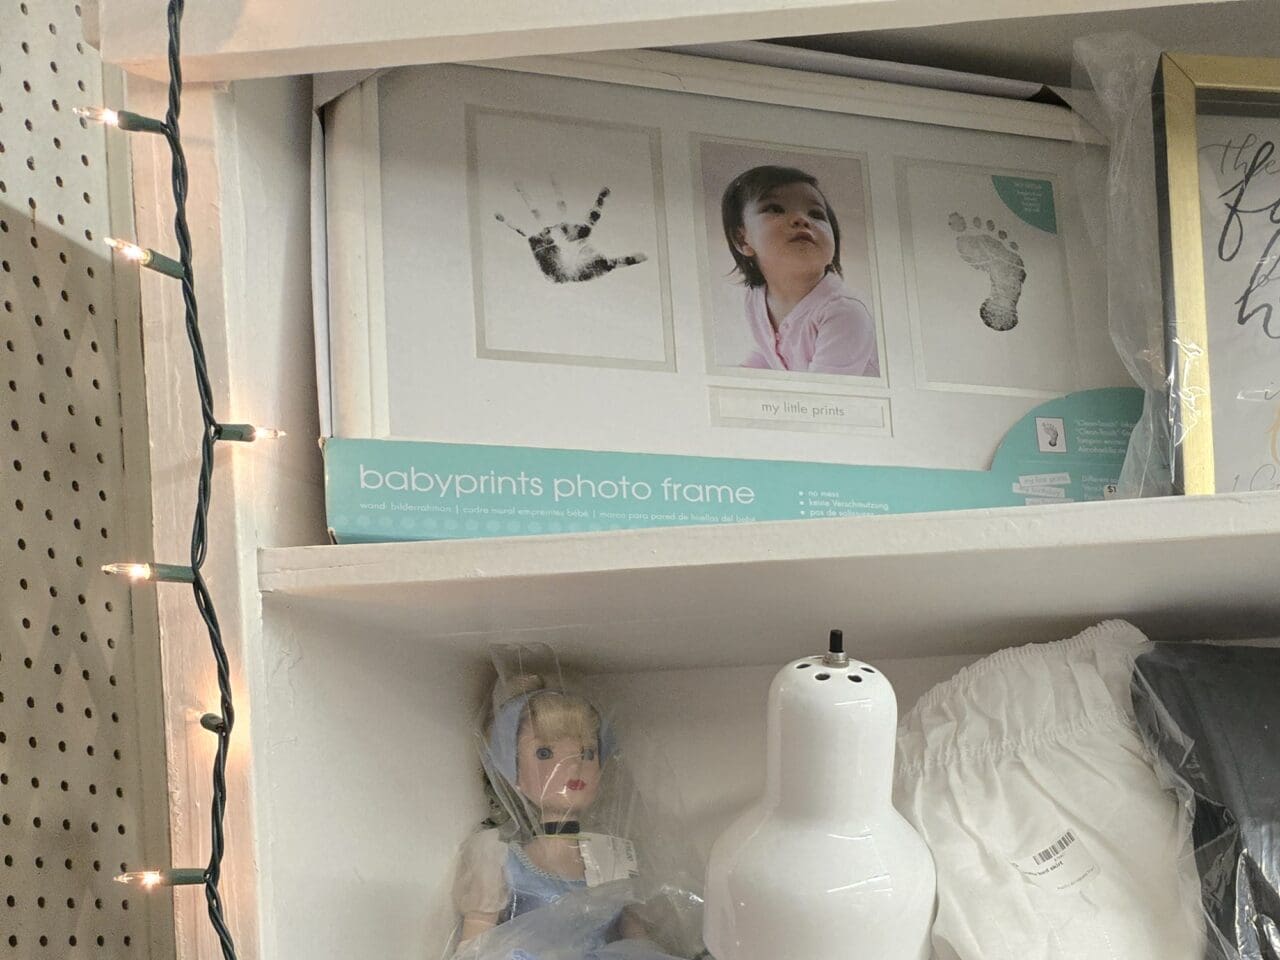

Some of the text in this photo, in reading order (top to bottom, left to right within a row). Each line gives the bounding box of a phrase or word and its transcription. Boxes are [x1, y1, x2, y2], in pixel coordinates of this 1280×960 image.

[761, 401, 845, 419] my little prints
[360, 464, 755, 504] babyprints photo frame
